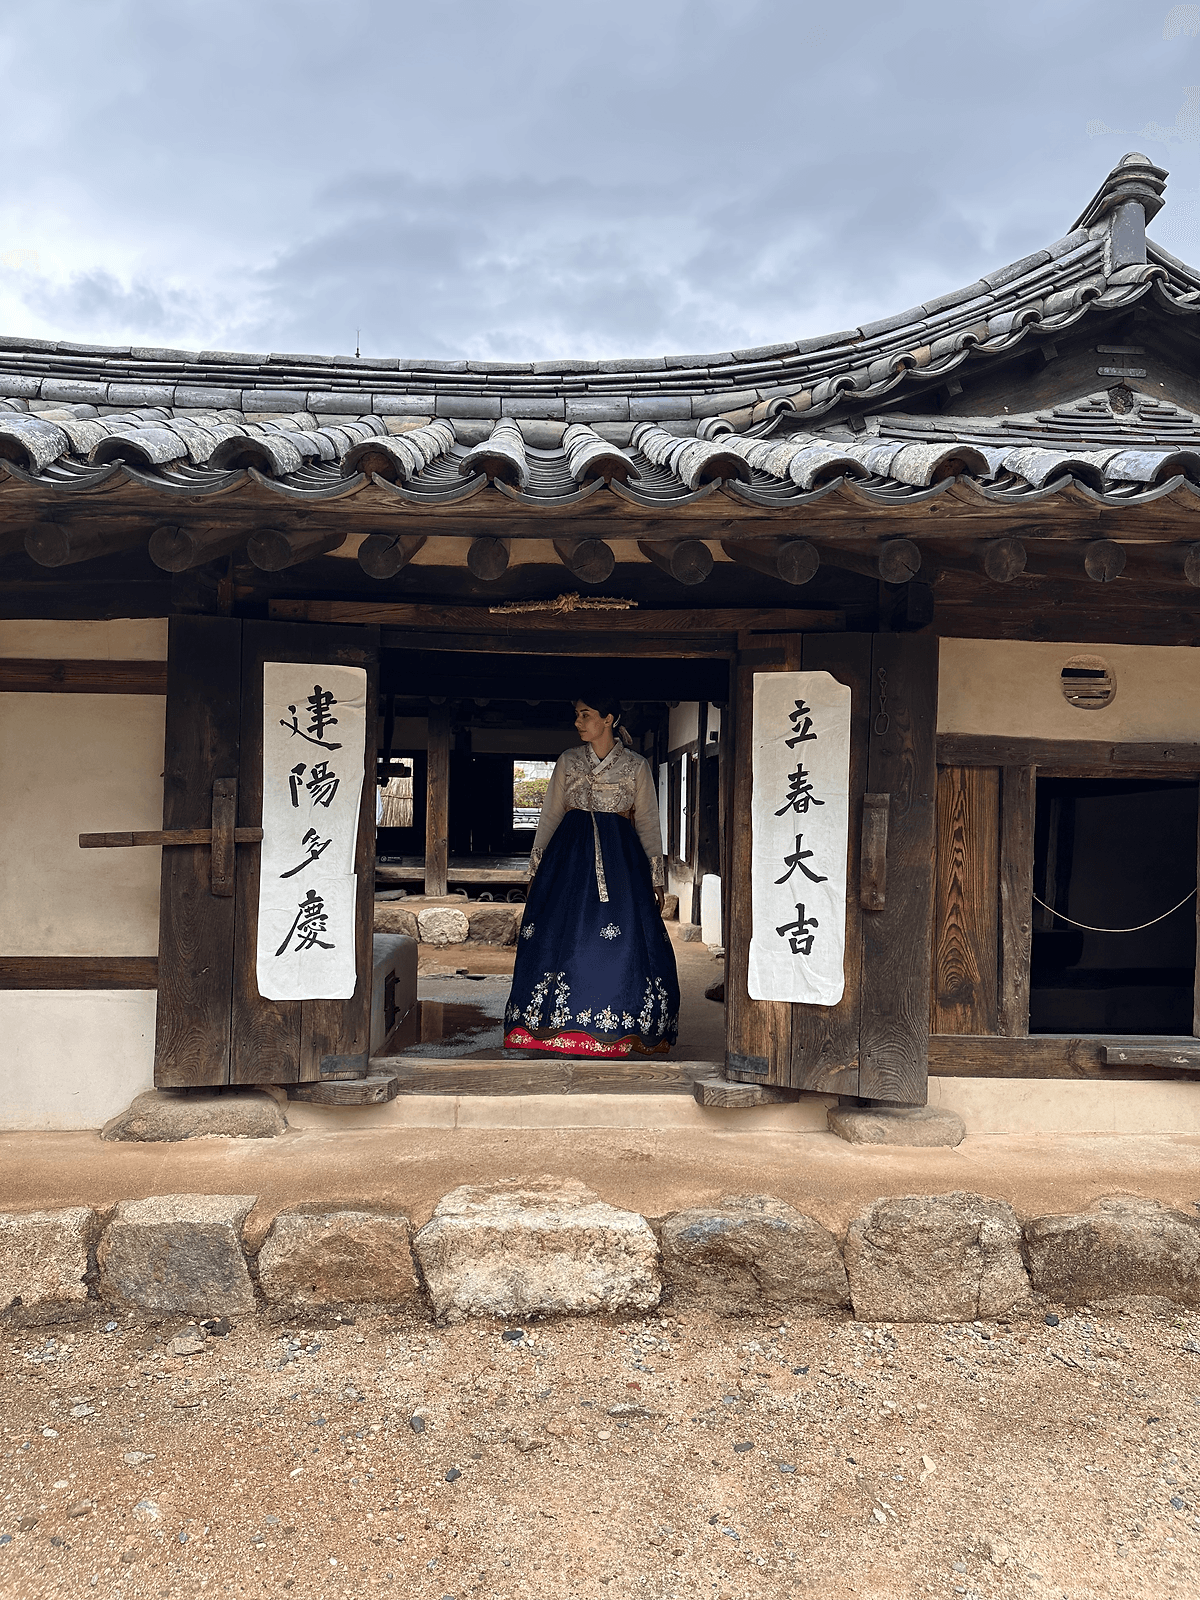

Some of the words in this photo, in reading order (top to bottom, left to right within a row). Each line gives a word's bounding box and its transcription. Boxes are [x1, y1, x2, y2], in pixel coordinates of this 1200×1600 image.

[275, 684, 344, 958] 建陽多慶
[774, 699, 829, 956] 立春大吉
